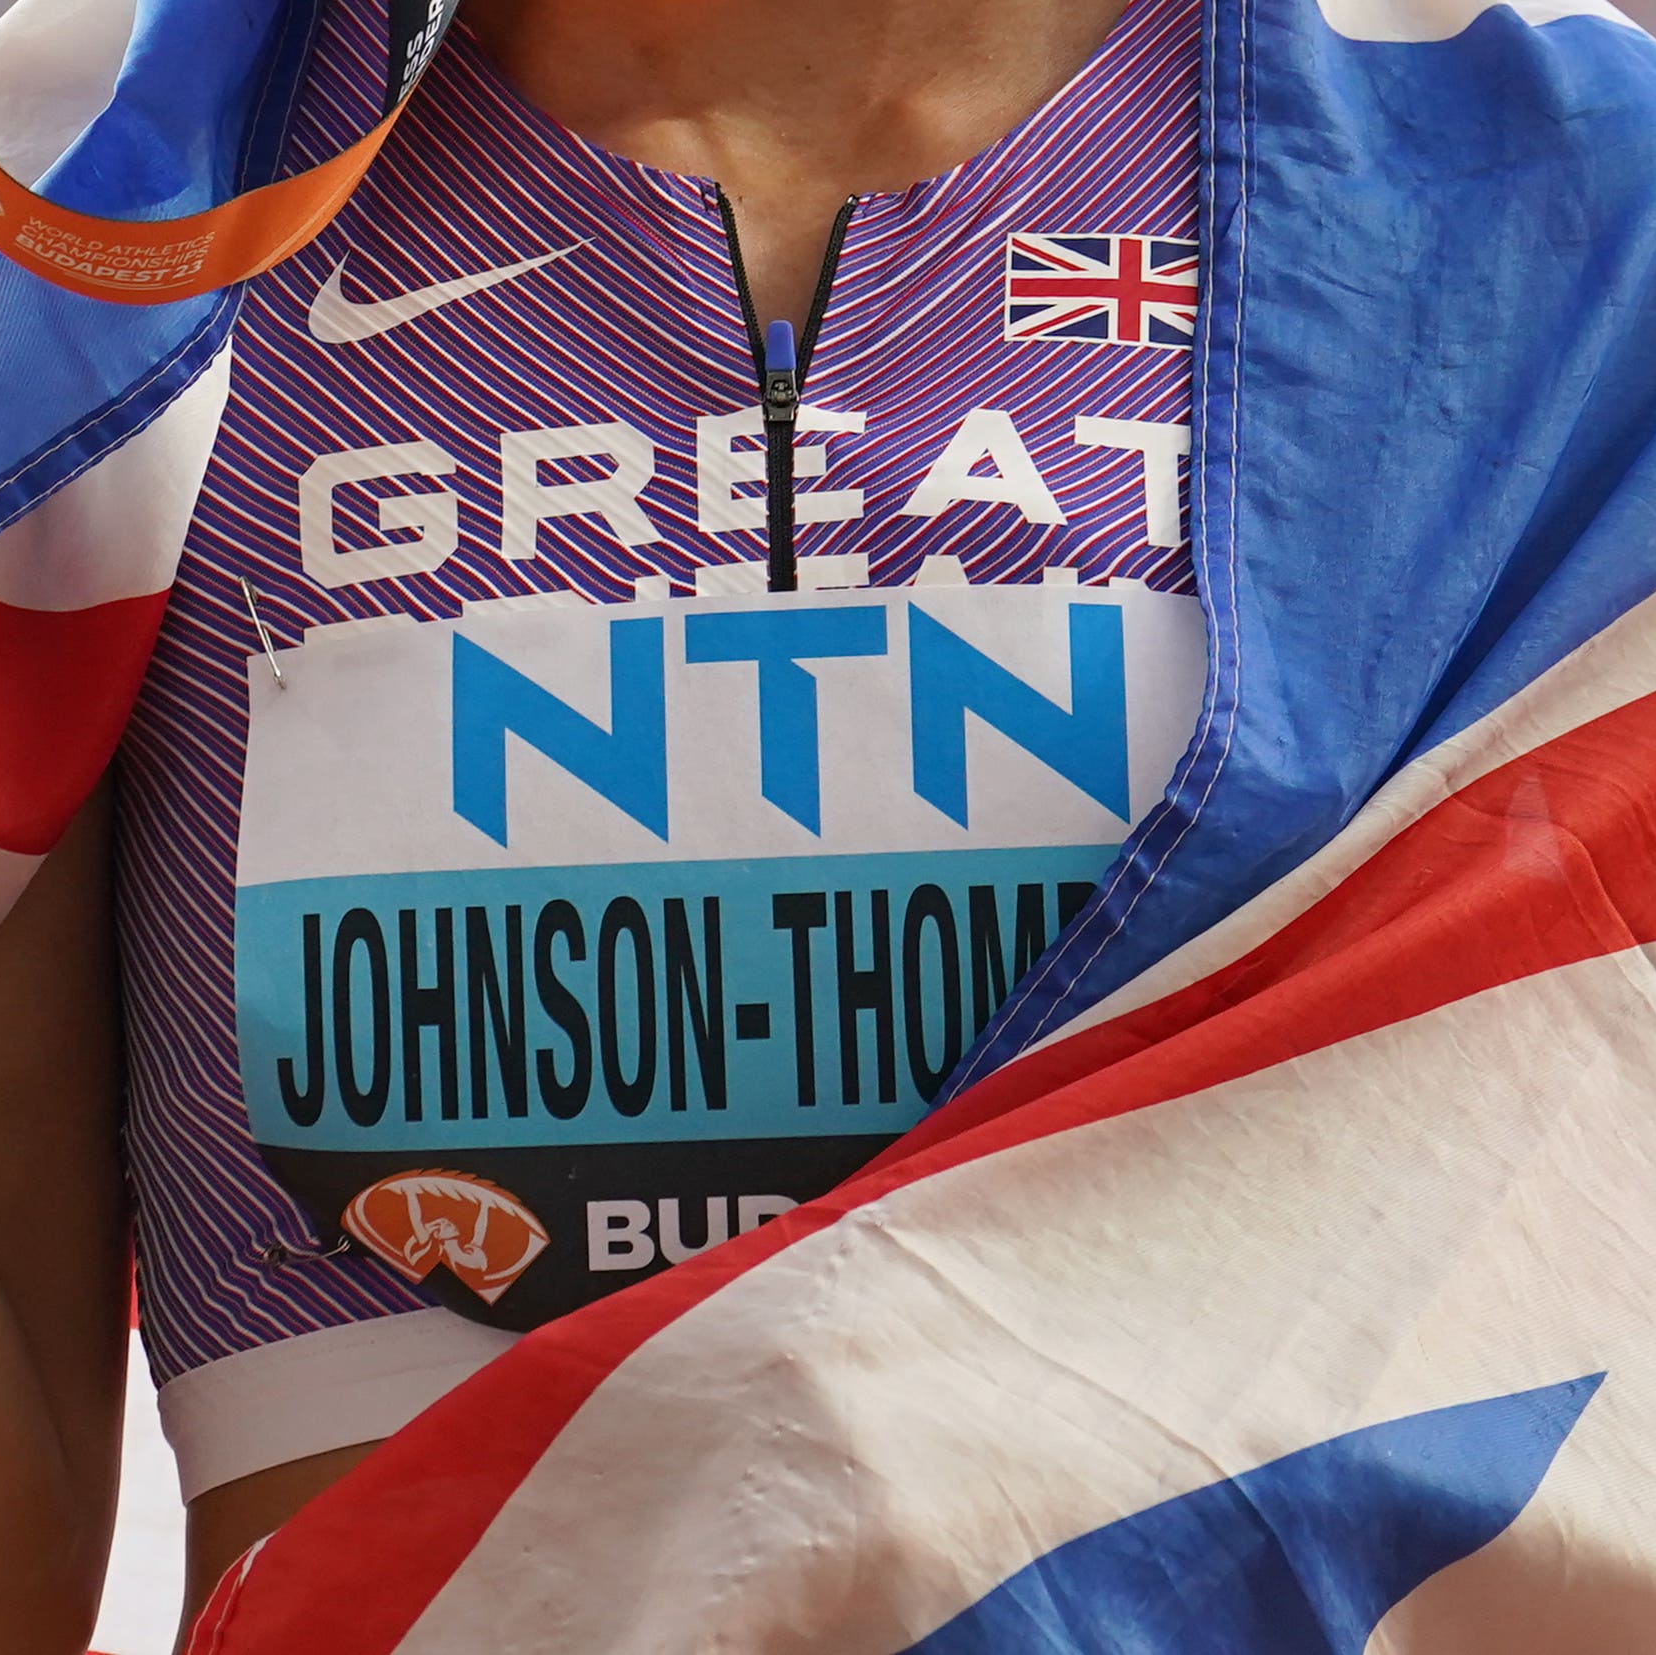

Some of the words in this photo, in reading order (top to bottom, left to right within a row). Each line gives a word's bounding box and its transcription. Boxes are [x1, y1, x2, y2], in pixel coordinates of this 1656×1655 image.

[14, 233, 171, 283] BUDAPEST
[172, 259, 204, 281] 23
[20, 224, 211, 270] CHAMPIONSHIPS
[28, 216, 104, 251] WORLD
[107, 231, 217, 258] ATHLETICS
[297, 406, 1192, 591] GREAT
[451, 600, 1131, 849] NTN
